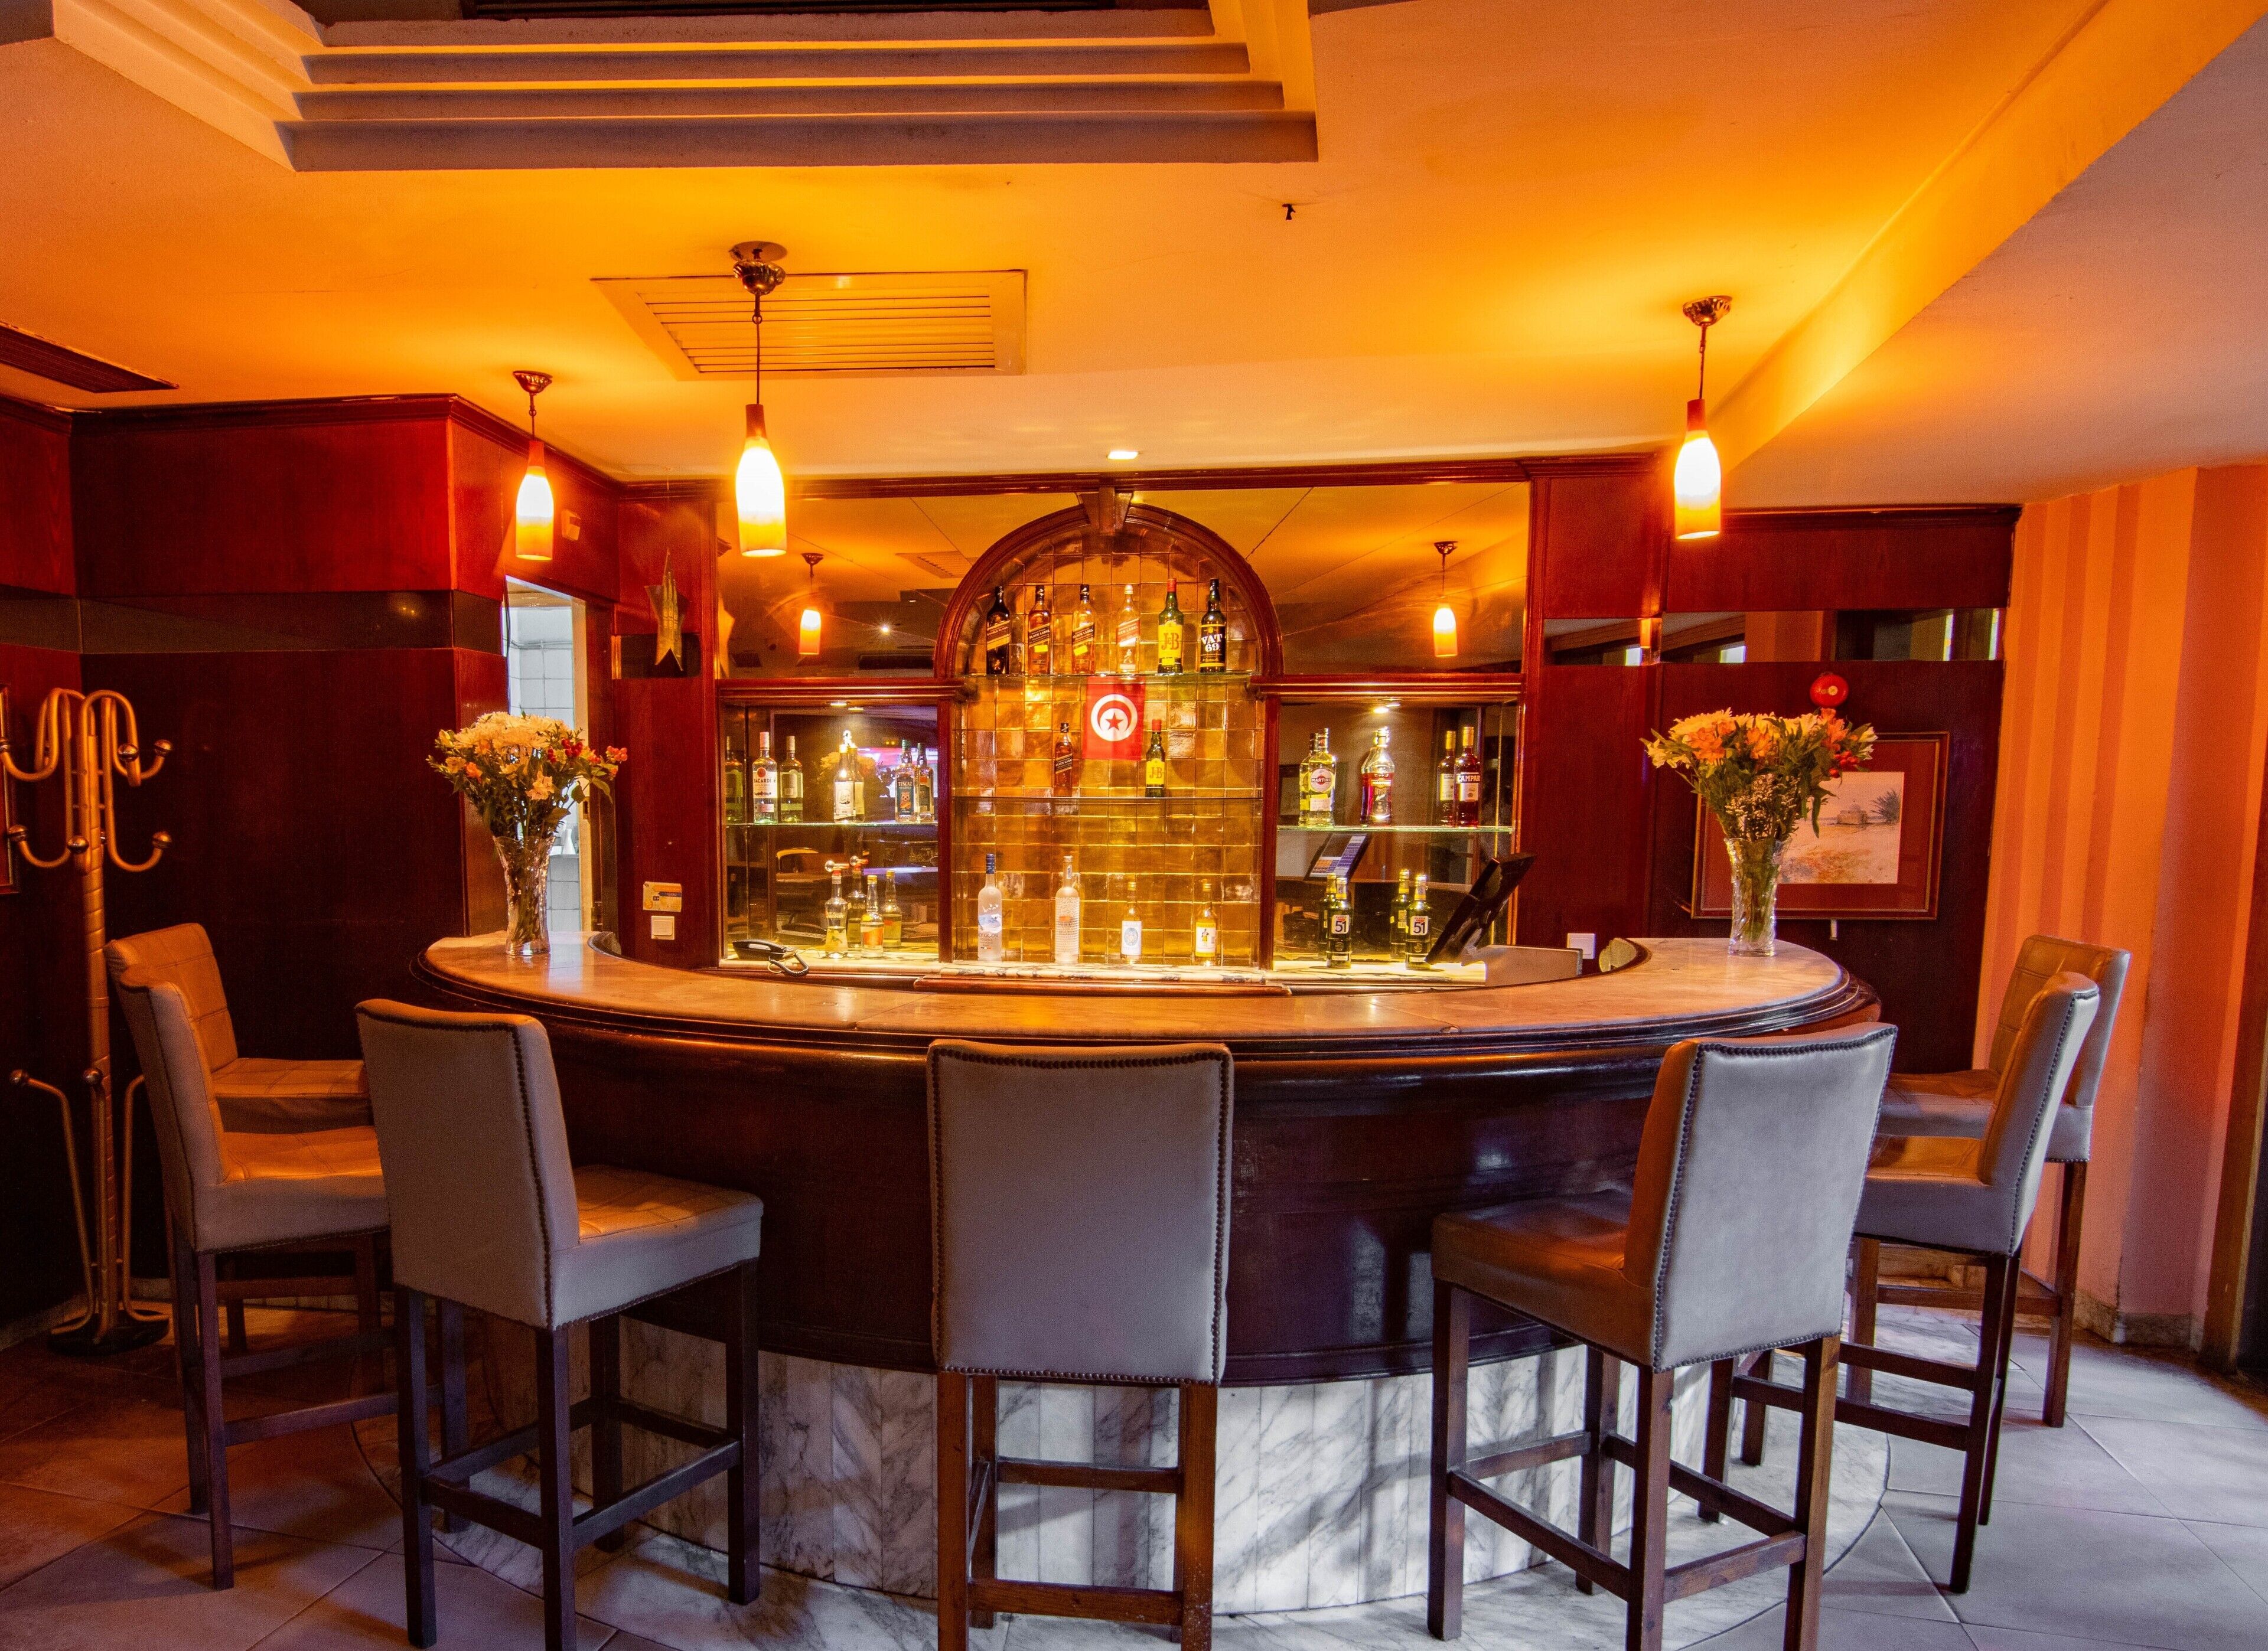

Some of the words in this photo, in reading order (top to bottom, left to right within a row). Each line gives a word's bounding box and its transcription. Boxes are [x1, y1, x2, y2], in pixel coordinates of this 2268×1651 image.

[1201, 634, 1223, 645] VAT
[1205, 642, 1220, 652] 69
[1335, 921, 1347, 932] 51
[1413, 922, 1426, 934] 51
